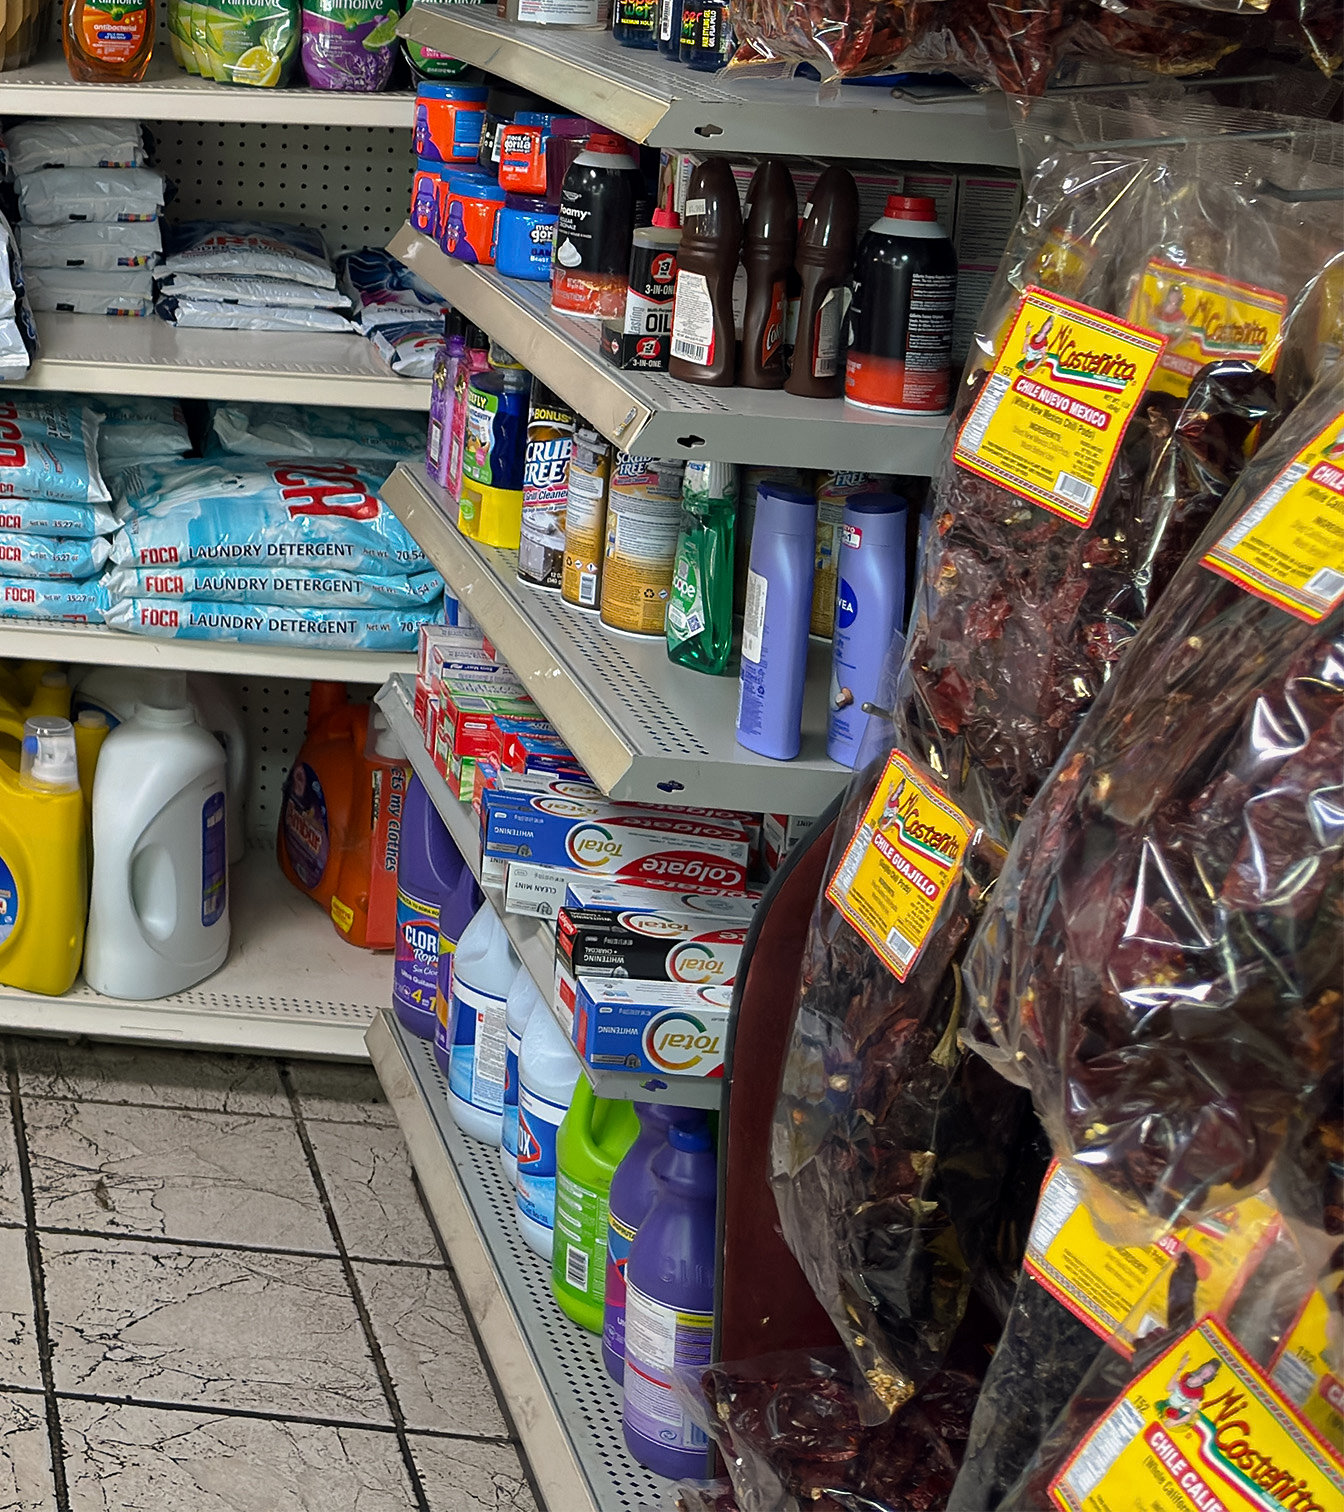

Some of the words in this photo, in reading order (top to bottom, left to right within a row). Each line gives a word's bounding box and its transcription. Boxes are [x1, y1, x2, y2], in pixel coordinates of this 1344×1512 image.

[624, 4, 651, 18] wet
[632, 359, 661, 368] 3-IN-ONE
[1058, 339, 1137, 381] Costeñita
[1016, 379, 1040, 397] CHILE
[1039, 390, 1070, 410] NUEVO
[1069, 402, 1106, 428] MEXICO
[140, 547, 178, 564] FOCA
[189, 544, 262, 559] LAUNDRY
[267, 543, 354, 556] DETERGENT
[145, 577, 184, 593] FOCA
[194, 578, 269, 591] LAUNDRY
[273, 579, 363, 593] DETERGENT
[4, 588, 35, 602] FOCA
[141, 608, 178, 627] FOCA
[189, 613, 263, 630] LAUNDRY
[268, 619, 357, 634] DETERGENT
[389, 795, 401, 818] my
[494, 826, 534, 838] WHITENING
[384, 820, 401, 872] clothes
[577, 839, 622, 859] Total
[641, 858, 742, 886] Colgate
[874, 834, 892, 860] CHILE
[892, 854, 936, 896] GUAJILLO
[515, 882, 533, 891] MINT
[535, 884, 557, 894] CLEAN
[584, 954, 625, 963] WHITENING
[679, 958, 724, 974] Total
[411, 989, 421, 1005] 4
[598, 1026, 638, 1035] WHITENING
[659, 1033, 720, 1054] Total
[1150, 1431, 1184, 1476] CHILE
